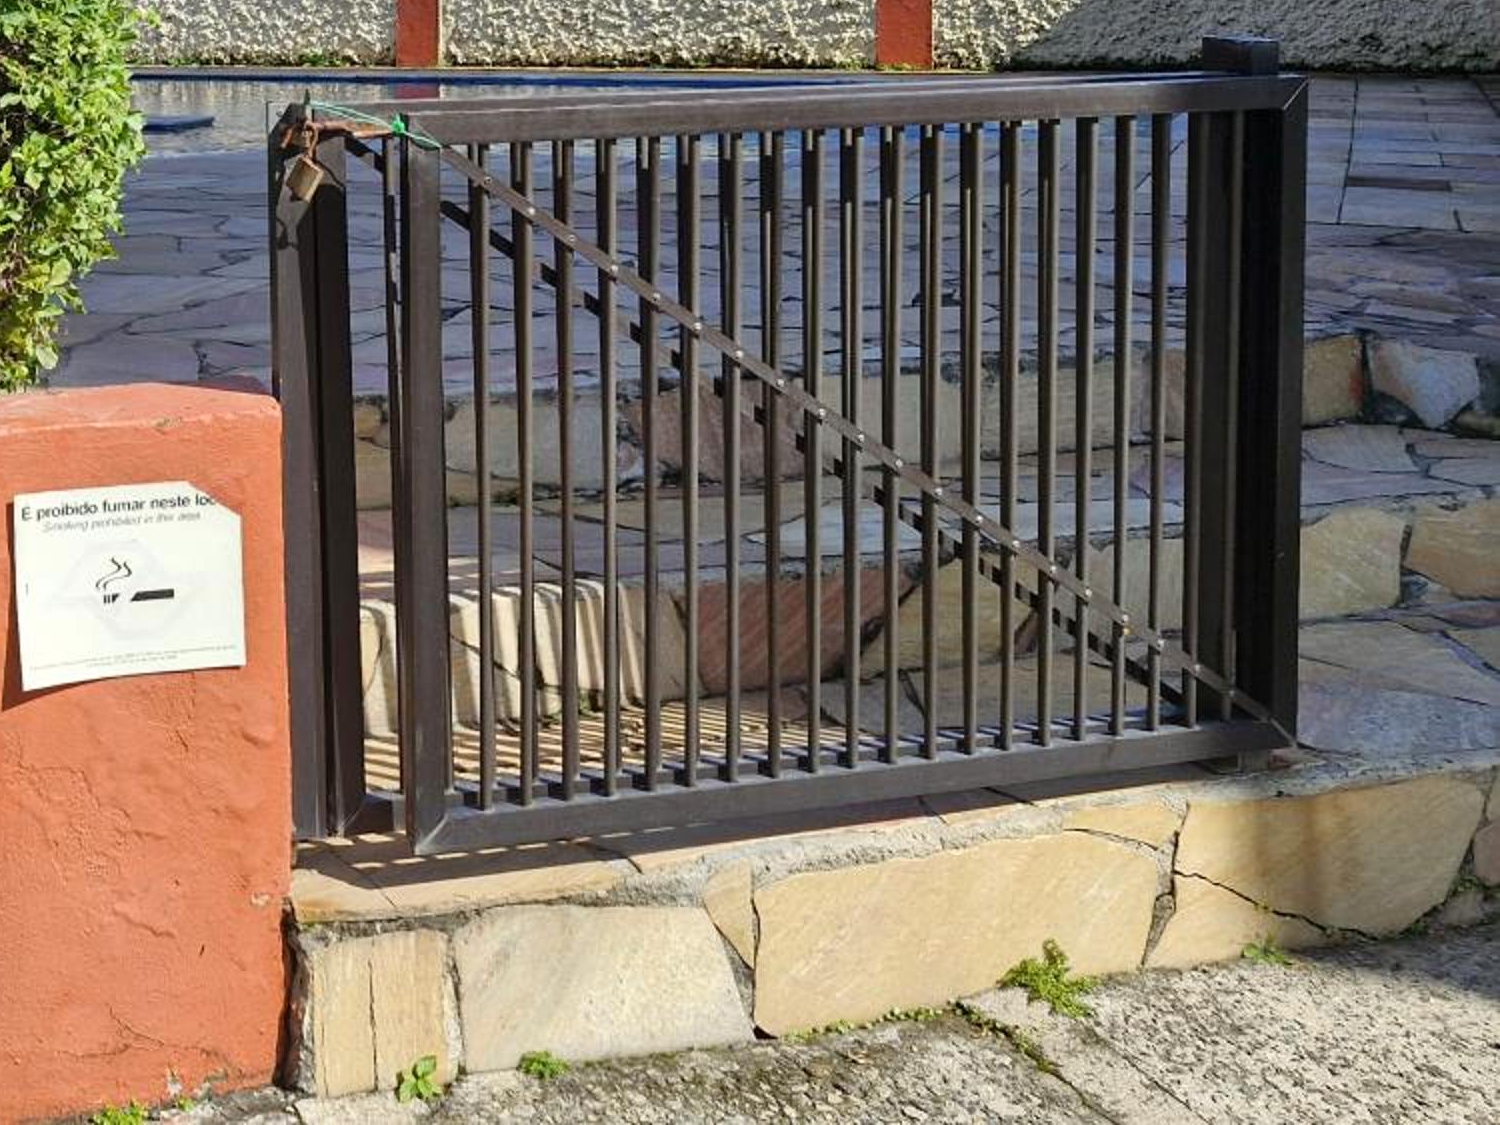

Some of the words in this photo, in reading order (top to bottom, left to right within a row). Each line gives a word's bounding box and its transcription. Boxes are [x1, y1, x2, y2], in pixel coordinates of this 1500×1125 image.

[36, 501, 99, 522] proibido
[102, 498, 145, 513] fumar
[149, 495, 191, 509] neste
